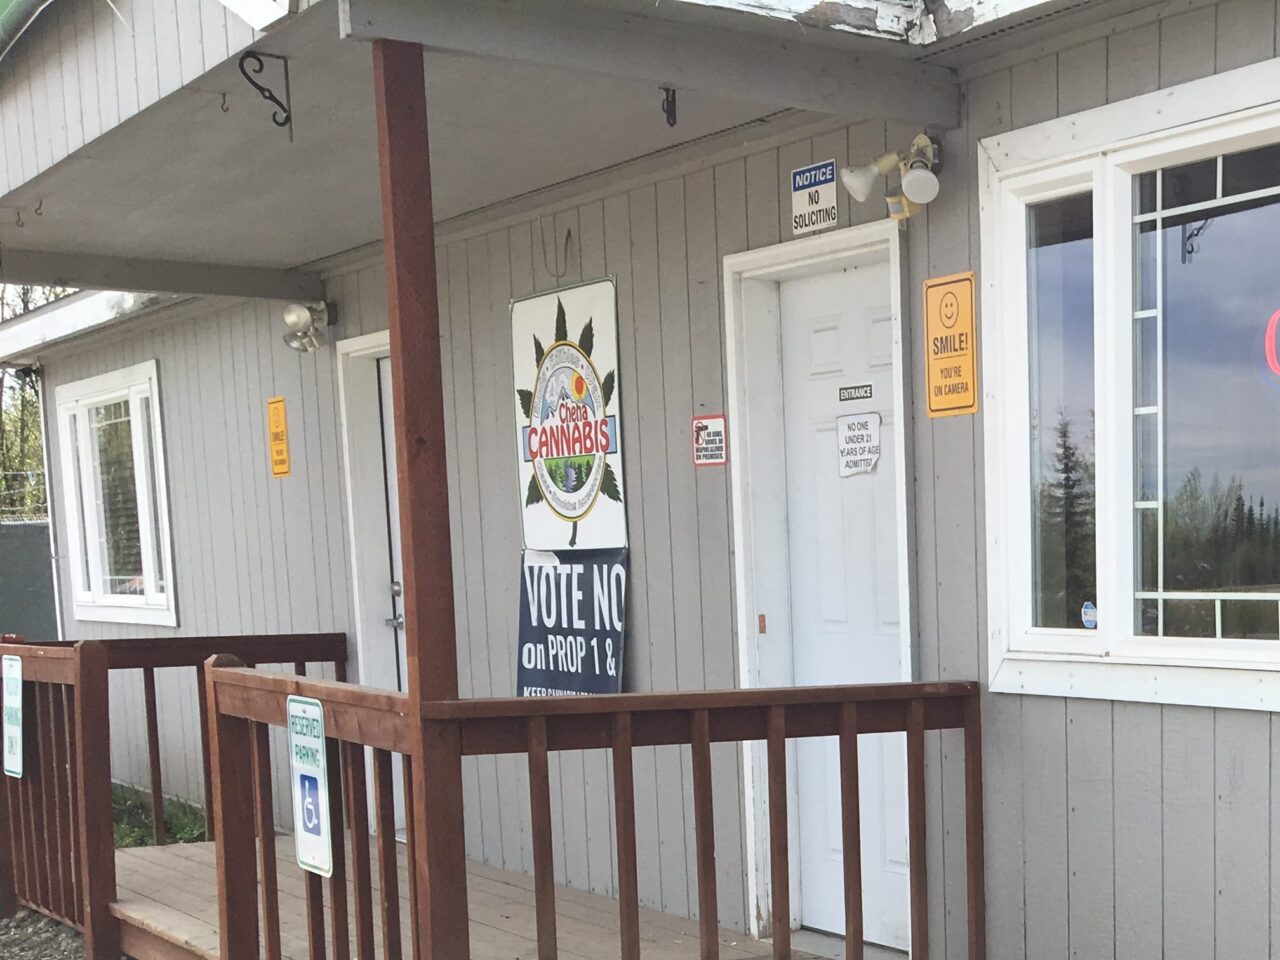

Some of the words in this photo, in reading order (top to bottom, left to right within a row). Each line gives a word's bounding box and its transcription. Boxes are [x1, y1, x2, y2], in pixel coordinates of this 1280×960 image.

[795, 166, 833, 187] NOTICE
[808, 189, 820, 206] NO
[793, 205, 837, 230] SOLICITING
[932, 332, 968, 356] SMILE!
[940, 365, 962, 379] YOU'RE
[840, 386, 872, 400] ENTRANCE
[934, 385, 943, 397] ON
[944, 381, 969, 396] CAMERA
[559, 402, 588, 424] Chena
[847, 422, 856, 432] NO
[857, 421, 869, 431] ONE
[527, 418, 610, 460] CANNABIS
[845, 434, 865, 445] UNDER
[866, 434, 872, 443] 21
[840, 447, 858, 457] YEARS
[859, 446, 867, 456] OF
[868, 445, 880, 455] AGE
[523, 564, 586, 629] VOTE
[593, 563, 626, 632] NO
[522, 642, 546, 670] on
[547, 634, 586, 673] PROP
[590, 637, 600, 675] 1
[605, 638, 616, 677] &
[290, 714, 321, 739] RESERVED
[295, 744, 320, 769] PARKING
